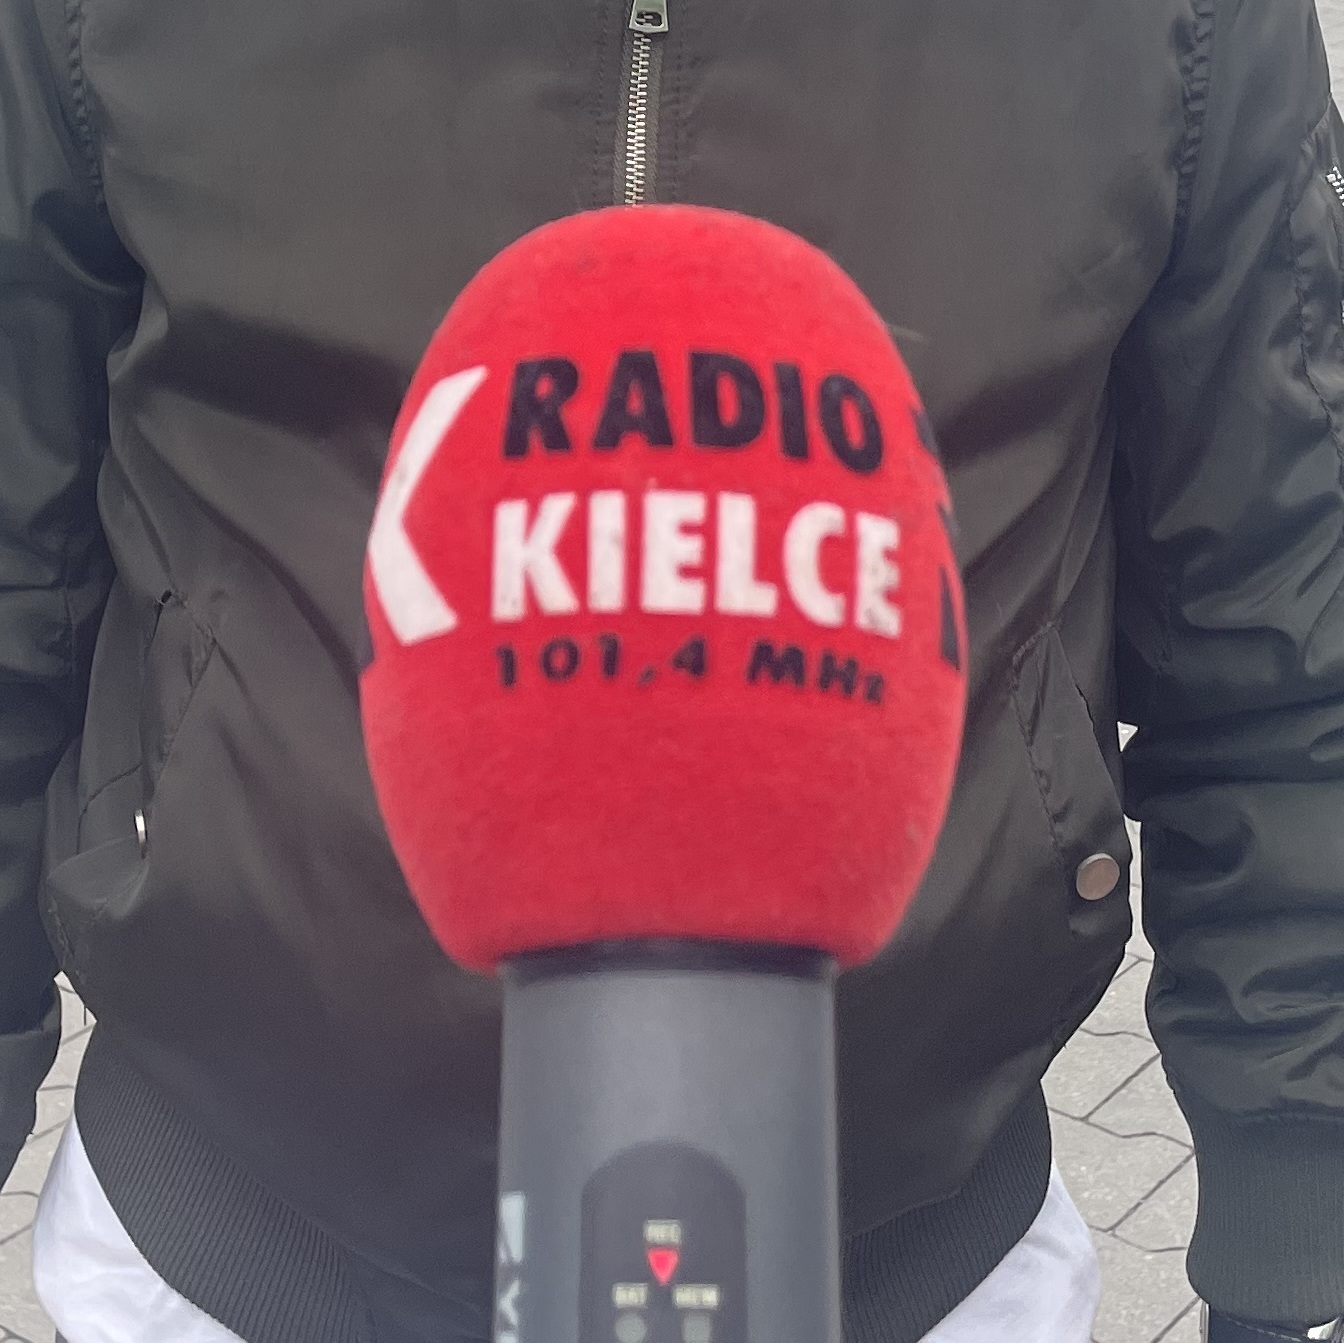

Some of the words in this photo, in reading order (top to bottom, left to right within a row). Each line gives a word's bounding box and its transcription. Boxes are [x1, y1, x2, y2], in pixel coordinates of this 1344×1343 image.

[504, 350, 885, 474] RADIO
[490, 488, 903, 639] KIELCE
[496, 632, 707, 688] 101,4
[746, 640, 885, 706] MHz
